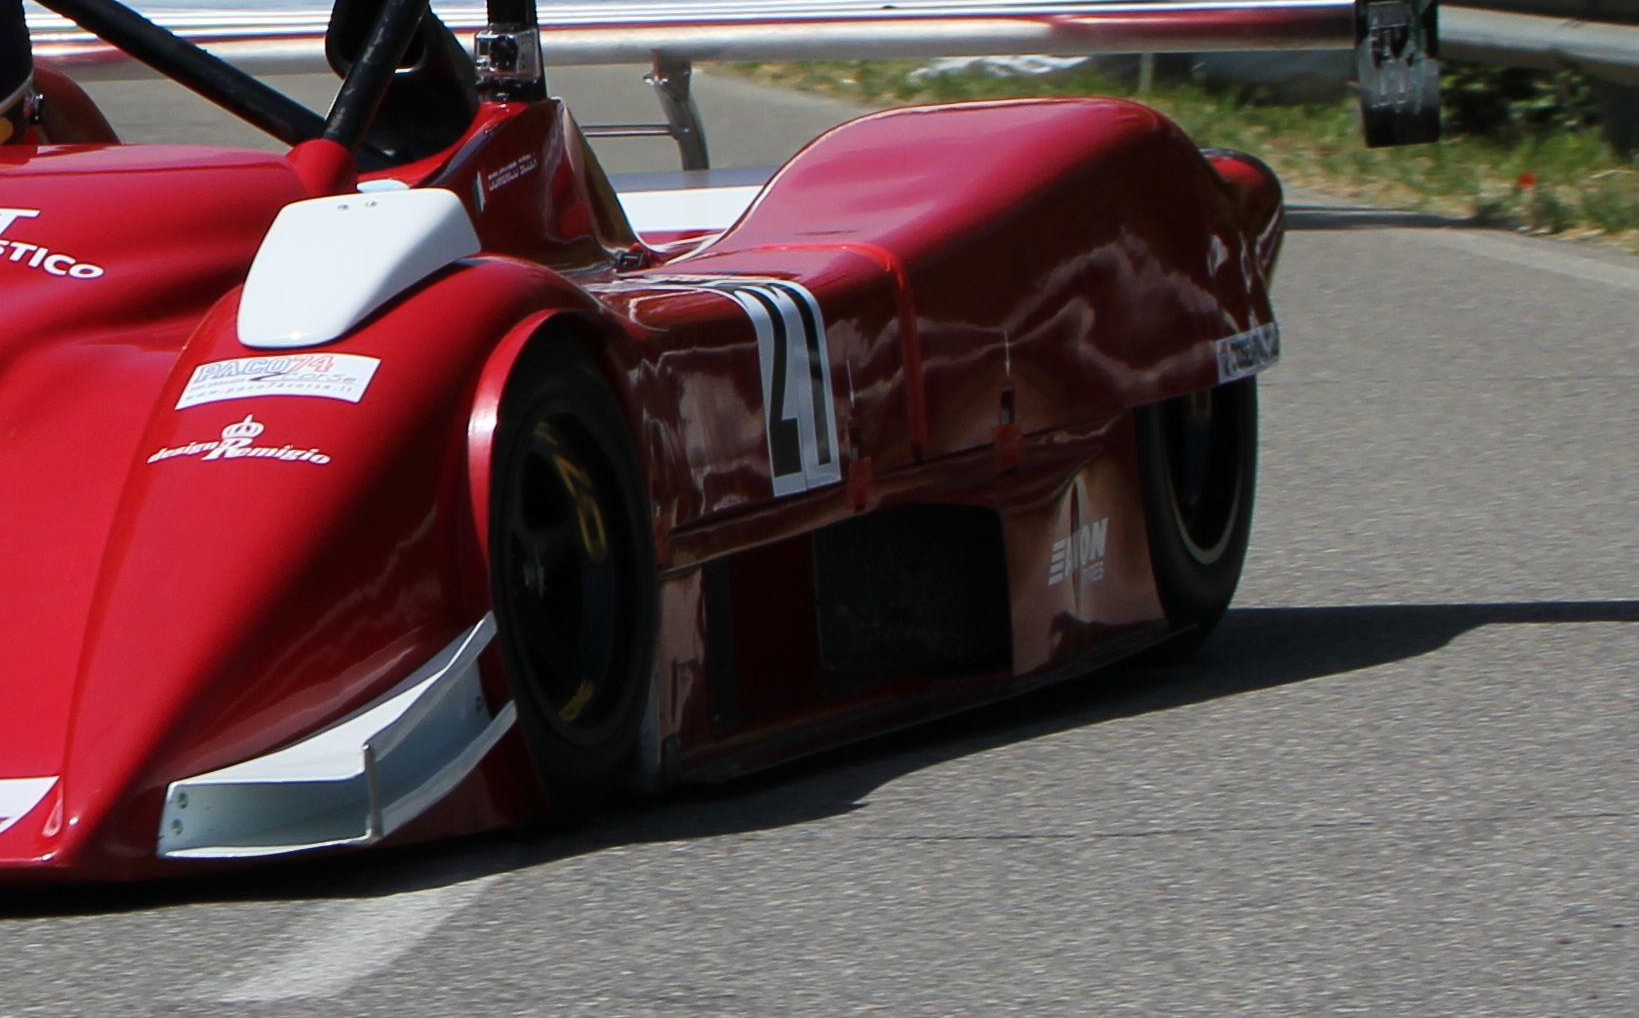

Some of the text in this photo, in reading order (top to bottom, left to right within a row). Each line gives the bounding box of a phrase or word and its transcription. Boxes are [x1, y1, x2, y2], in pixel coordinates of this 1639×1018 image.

[196, 354, 336, 383] PACO74
[147, 437, 331, 464] design Remigio
